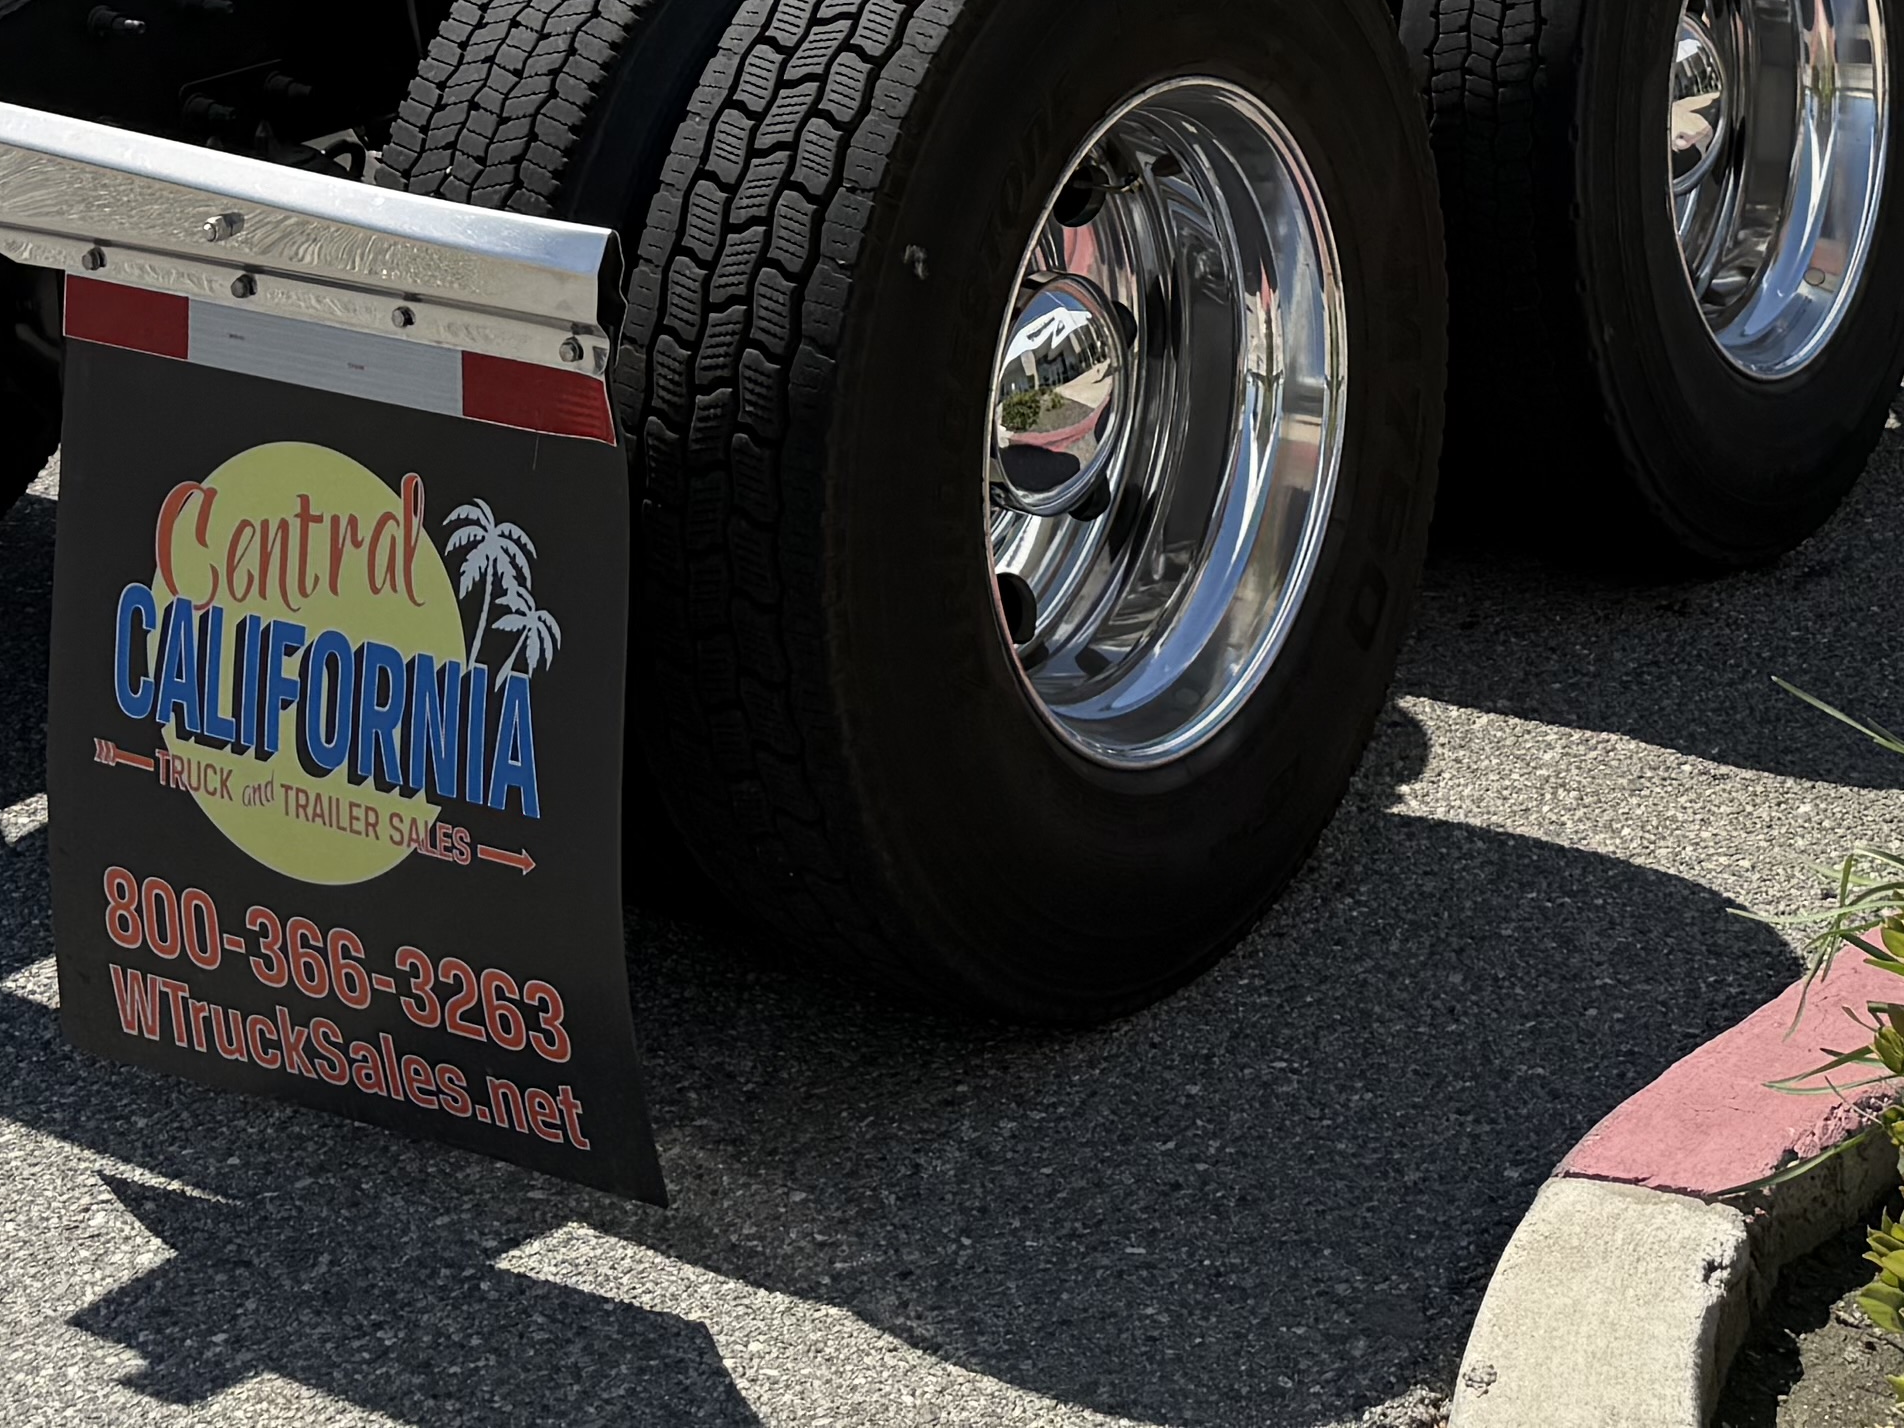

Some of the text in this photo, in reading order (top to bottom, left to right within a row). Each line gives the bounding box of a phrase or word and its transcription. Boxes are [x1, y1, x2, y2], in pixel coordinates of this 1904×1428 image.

[156, 472, 425, 612] Central
[114, 582, 540, 819] CALIFORNIA
[155, 749, 472, 865] TRUCK and TRAILER SALES
[103, 865, 571, 1063] 800-366-3263
[109, 963, 590, 1150] WTruckSales.net
